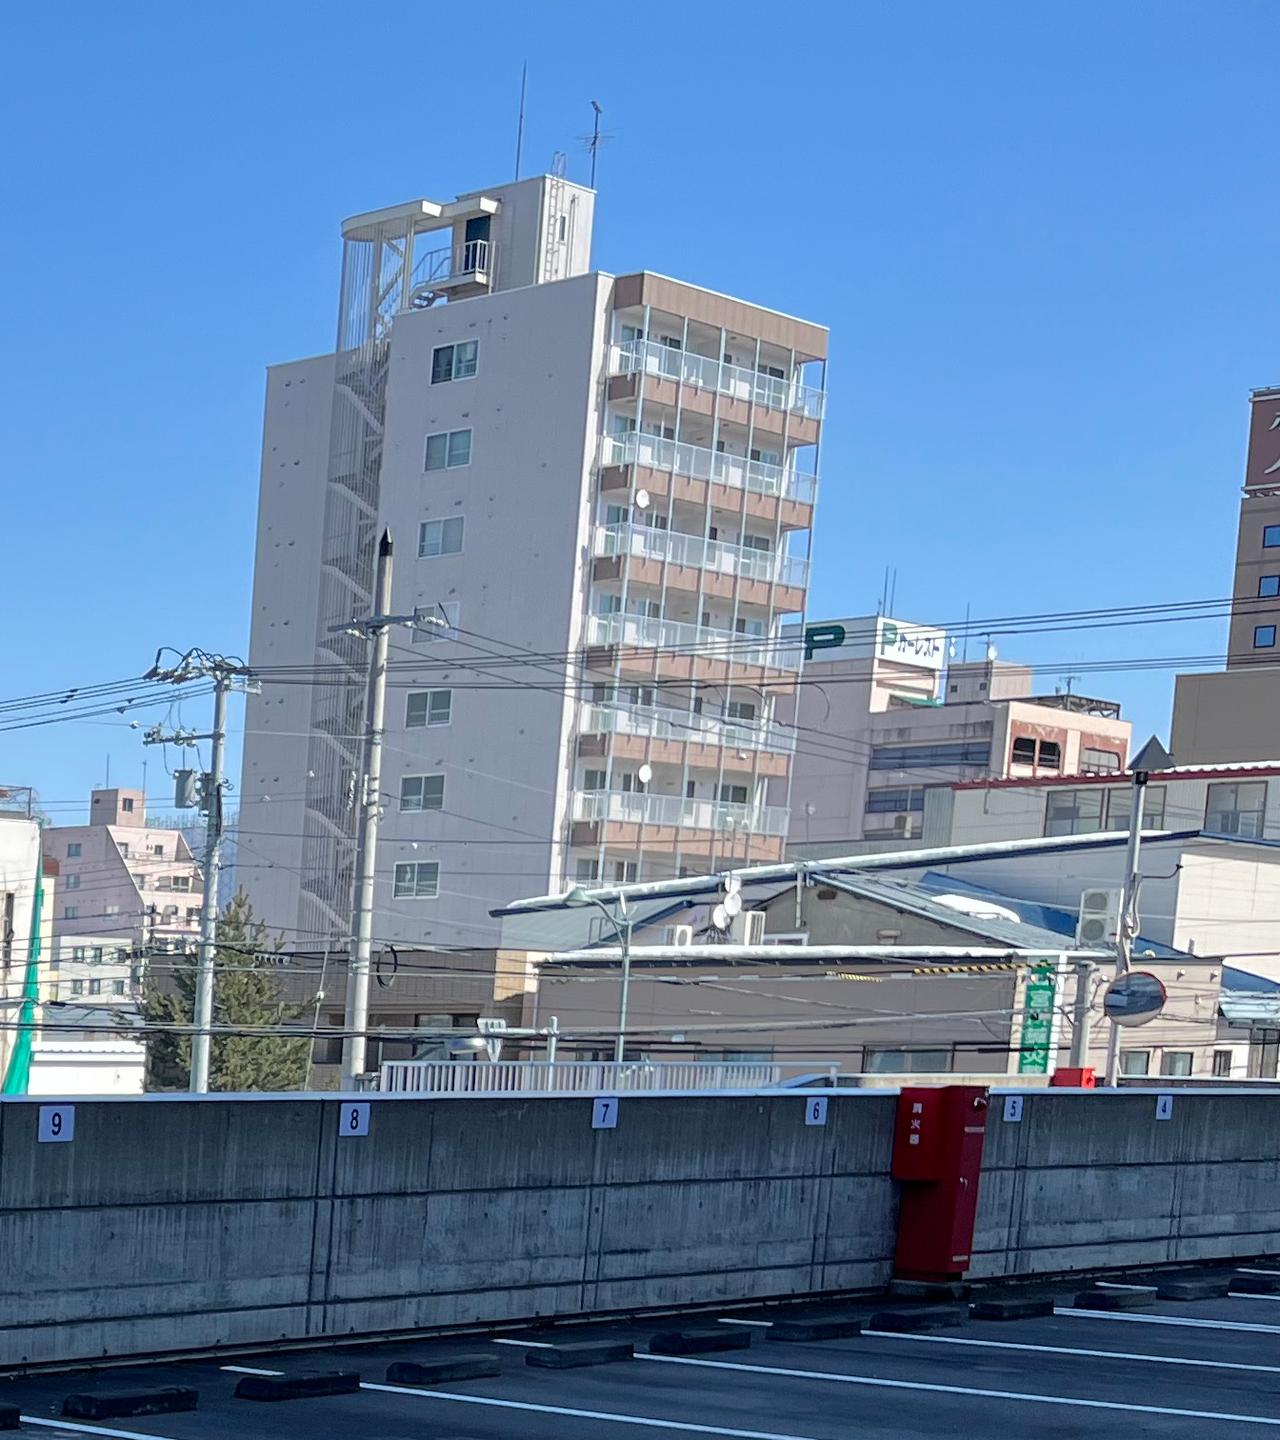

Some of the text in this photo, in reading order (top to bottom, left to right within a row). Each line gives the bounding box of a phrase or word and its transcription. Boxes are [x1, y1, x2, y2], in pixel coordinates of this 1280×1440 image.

[350, 1108, 359, 1130] 8
[602, 1103, 610, 1123] 7
[812, 1102, 820, 1120] 6
[1009, 1101, 1017, 1118] 5
[51, 1112, 62, 1136] 9
